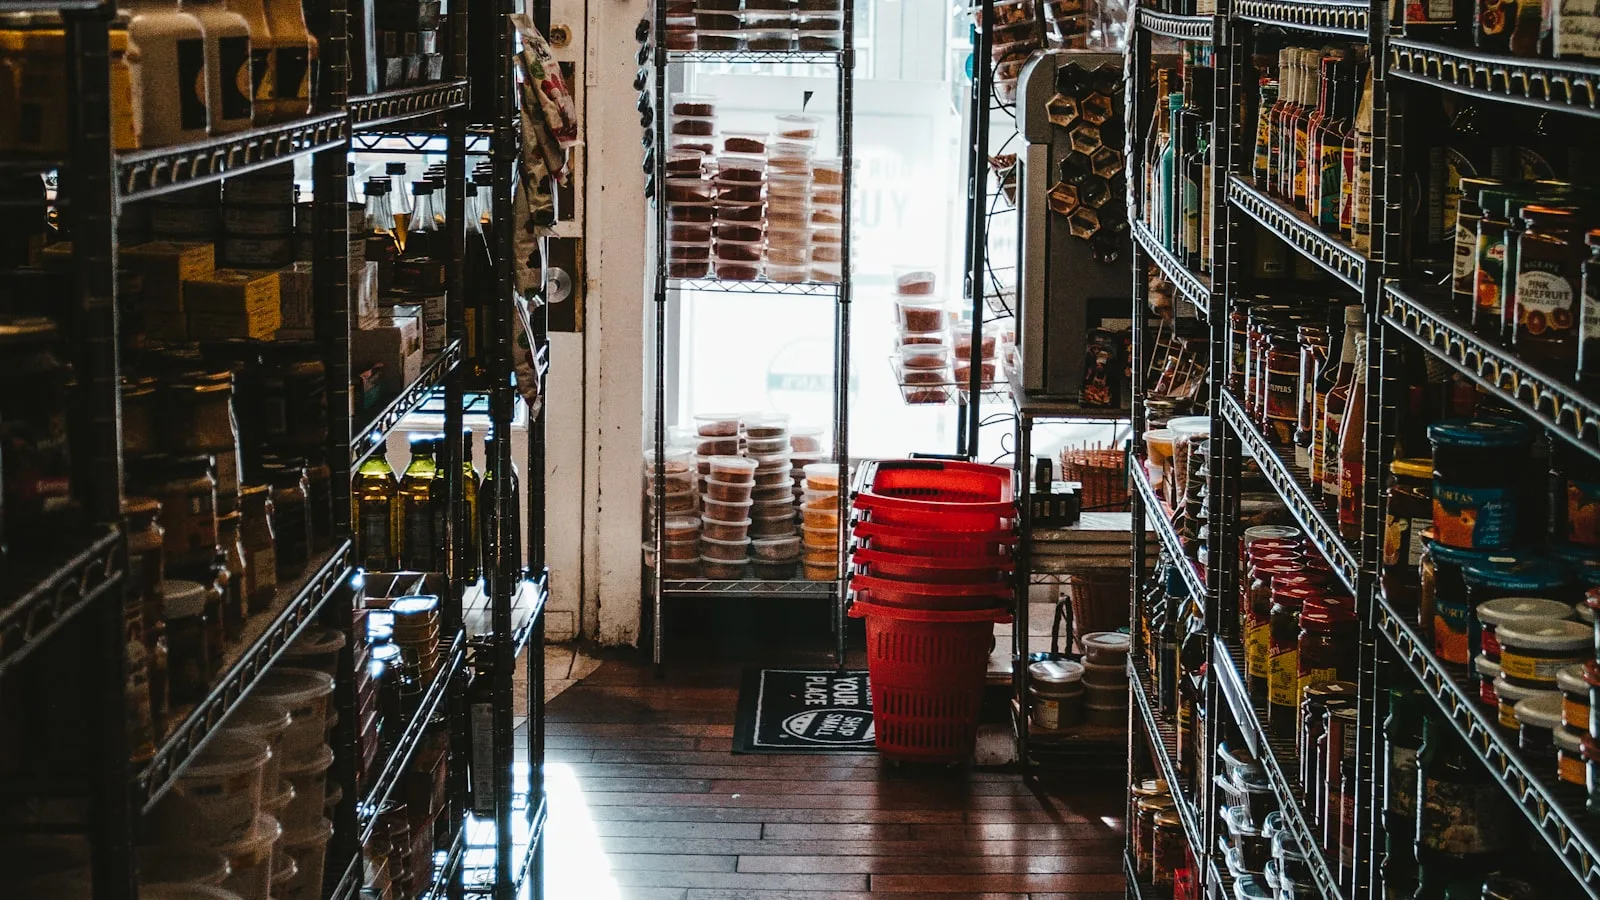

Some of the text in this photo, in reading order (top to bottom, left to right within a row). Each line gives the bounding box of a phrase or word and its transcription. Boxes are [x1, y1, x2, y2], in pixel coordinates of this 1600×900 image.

[1518, 287, 1570, 300] RAPEFRUIT
[1528, 280, 1549, 290] PINK
[804, 676, 827, 705] PLACE
[833, 676, 858, 705] YOUR
[814, 713, 844, 736] SMALL
[837, 716, 864, 736] SHOP
